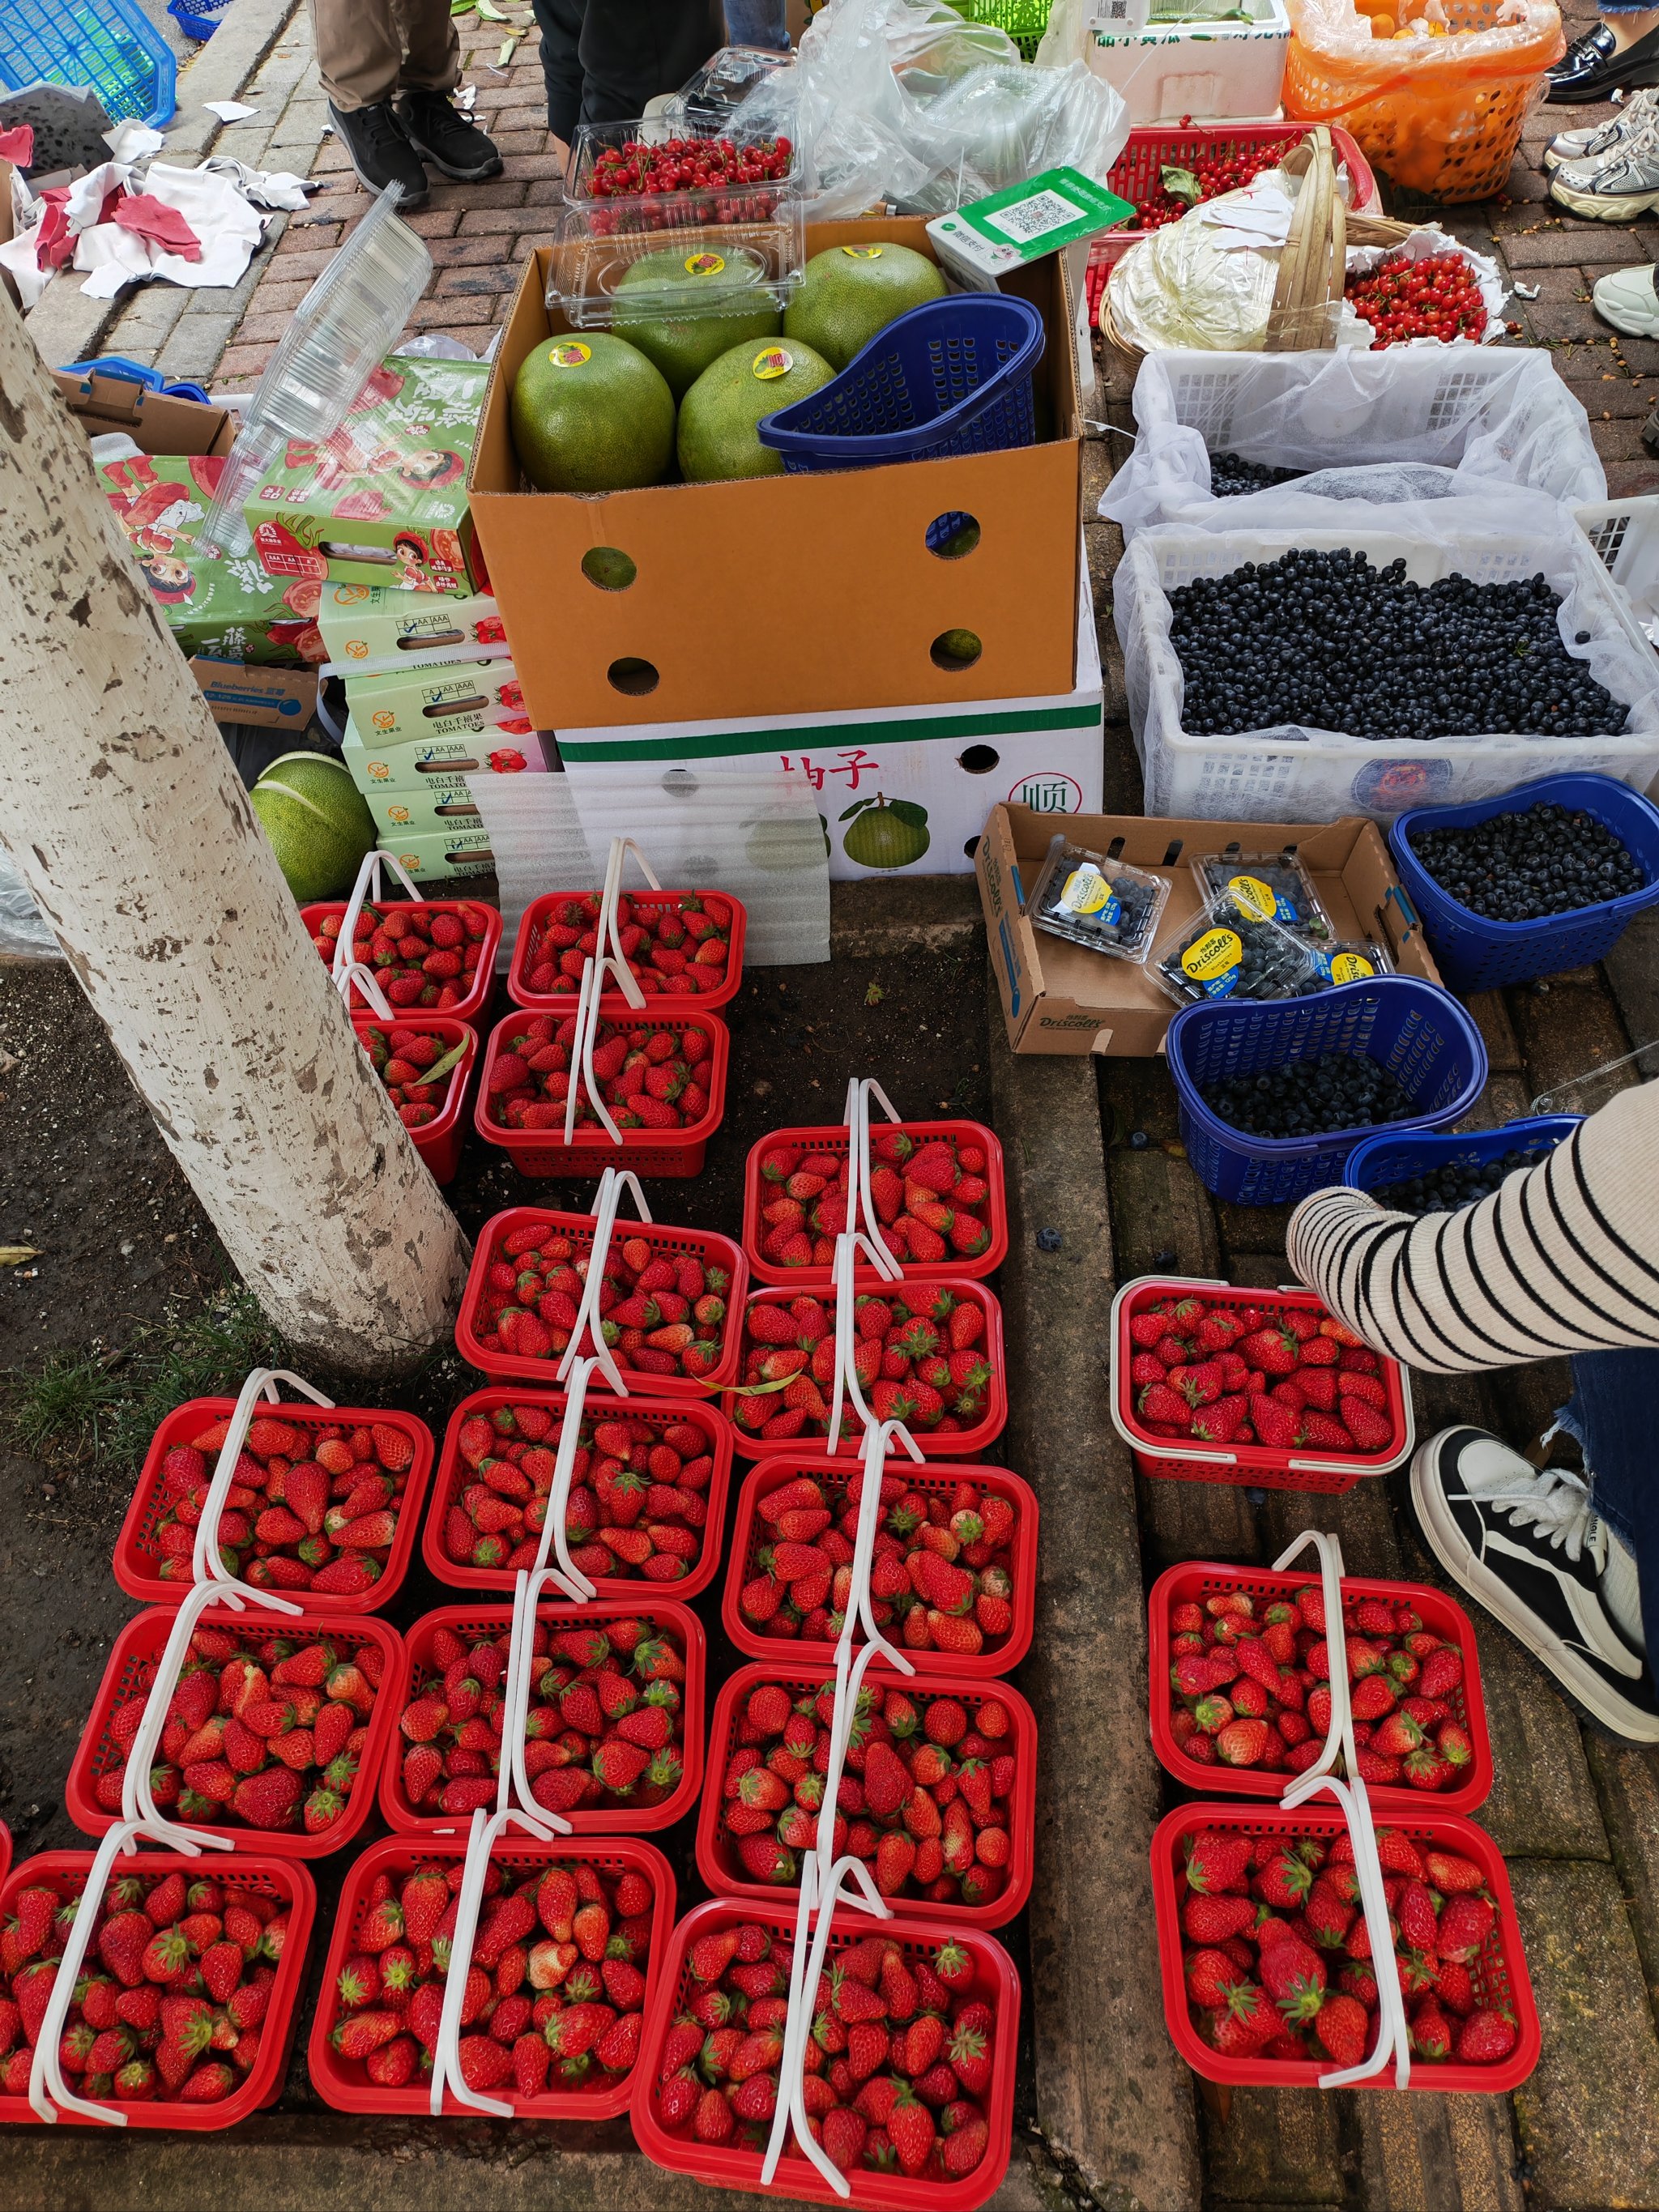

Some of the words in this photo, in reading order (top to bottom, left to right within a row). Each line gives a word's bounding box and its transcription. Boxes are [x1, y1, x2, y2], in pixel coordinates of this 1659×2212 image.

[953, 230, 984, 252] 微信支付
[211, 680, 263, 693] Blueberries
[433, 714, 484, 729] 电白千禧果
[435, 721, 485, 735] TOMATOES
[374, 727, 402, 735] 文生果业
[369, 777, 396, 785] 文生果业
[1022, 781, 1068, 813] 顺
[1185, 932, 1233, 973] Driscoll's
[1199, 964, 1207, 972] Only
[1210, 953, 1232, 970] Blueberries
[1039, 1017, 1102, 1029] Driscoll's
